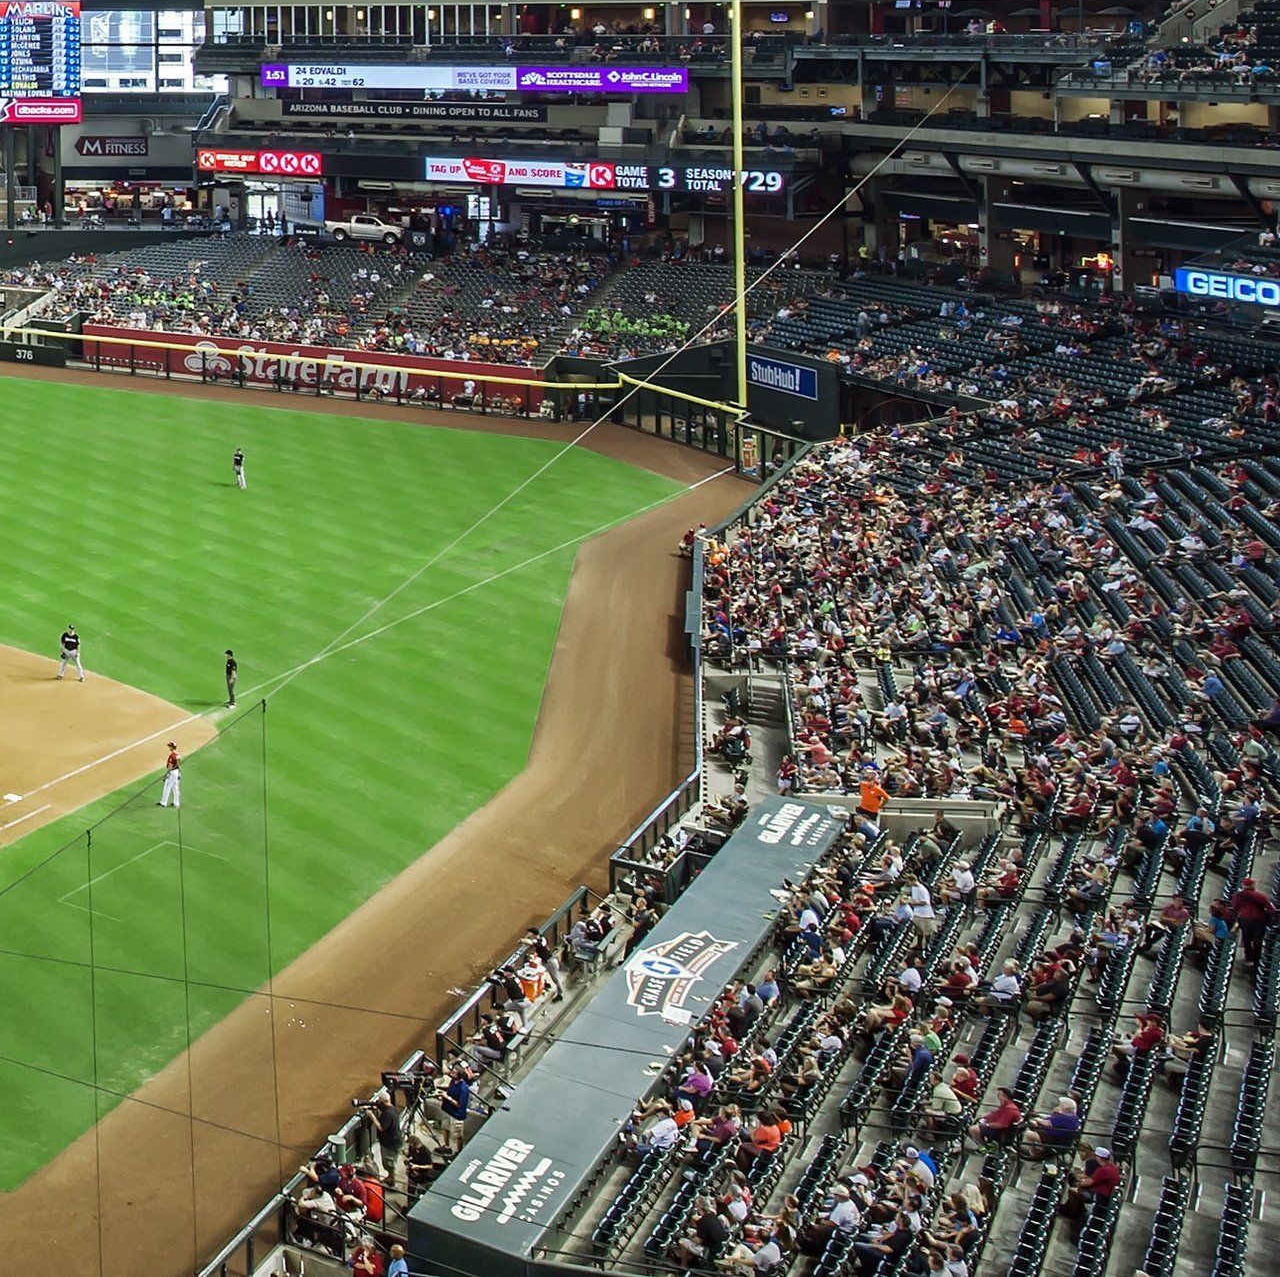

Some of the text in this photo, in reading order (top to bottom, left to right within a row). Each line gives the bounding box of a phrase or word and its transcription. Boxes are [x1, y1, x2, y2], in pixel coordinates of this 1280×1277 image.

[6, 2, 73, 17] MARLINS
[265, 71, 285, 79] 1:51
[309, 67, 346, 75] EOVALDI
[302, 78, 364, 86] 20 42 62
[19, 106, 74, 114] dbacks.com
[290, 104, 327, 112] ARIZONA
[330, 105, 375, 113] BASEBALL
[378, 106, 402, 114] CLUB
[413, 107, 446, 115] DINING
[449, 108, 475, 116] OPEN
[106, 143, 146, 153] FITNESS
[615, 166, 647, 177] GAME
[658, 168, 675, 187] 3
[686, 168, 731, 181] SEASON
[615, 177, 649, 188] TOTAL
[686, 179, 721, 191] TOTAL
[1187, 272, 1279, 305] GEICO
[16, 350, 33, 359] 376
[236, 344, 409, 400] State Farm
[751, 361, 800, 391] StubHub!
[641, 978, 666, 1006] CHASE
[670, 939, 704, 961] FIELD
[519, 1170, 565, 1222] CASINOS
